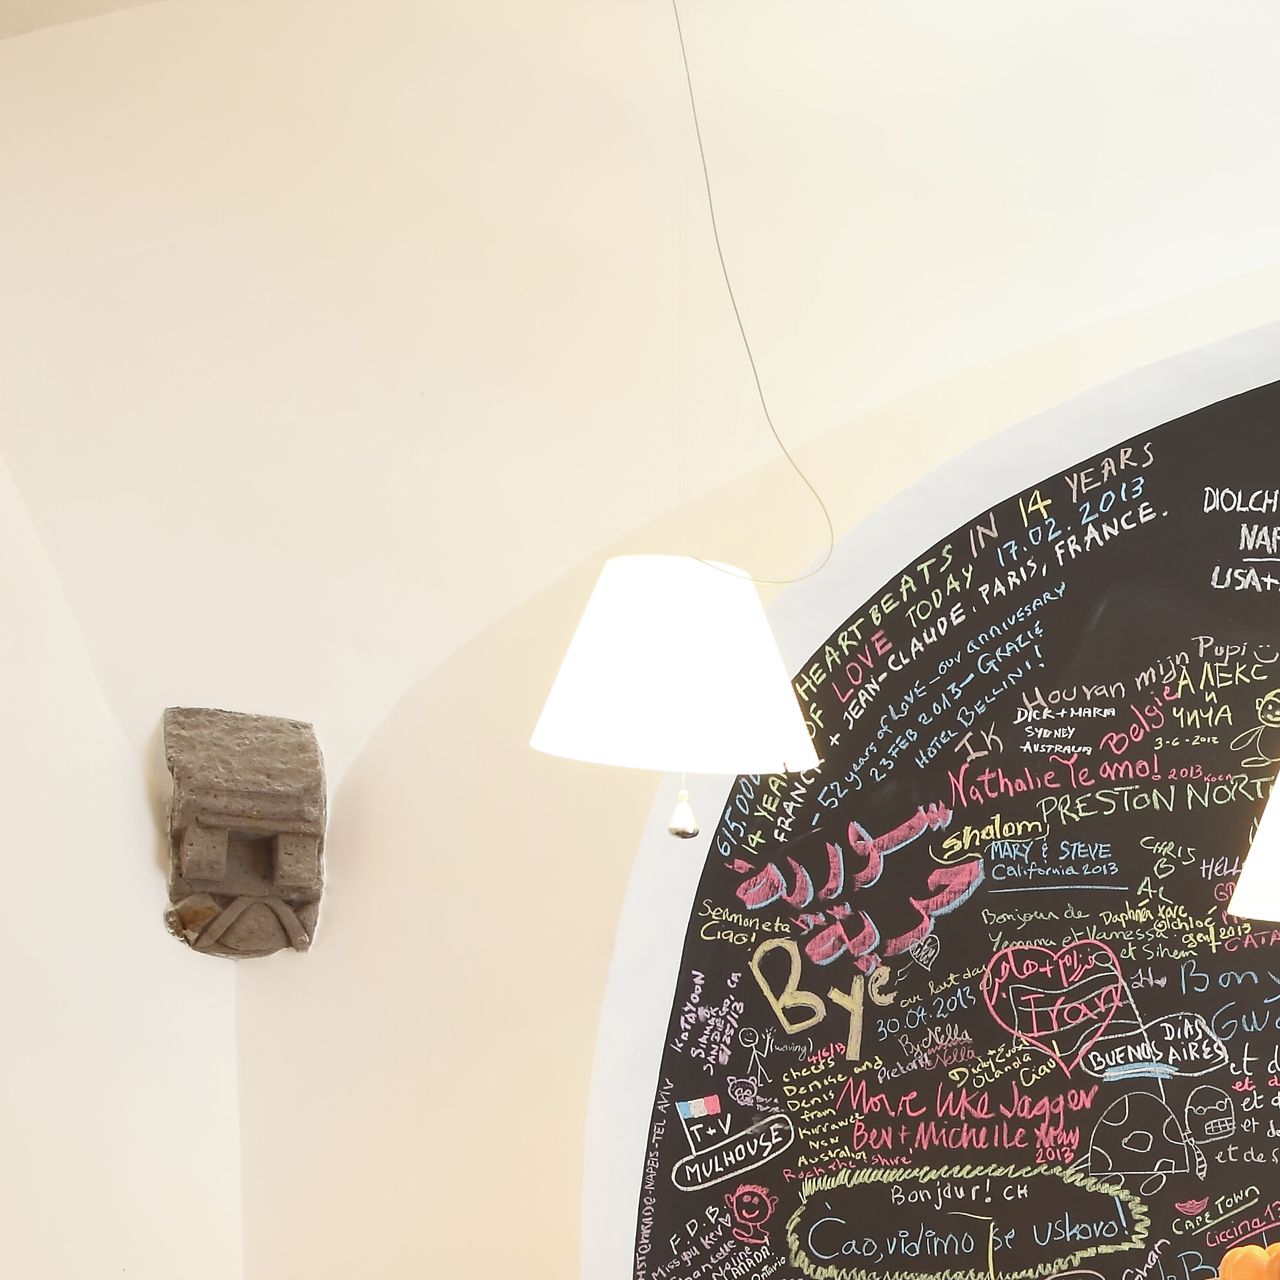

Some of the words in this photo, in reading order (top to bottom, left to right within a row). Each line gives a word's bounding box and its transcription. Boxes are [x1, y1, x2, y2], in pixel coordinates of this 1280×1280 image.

[968, 512, 999, 558] IN
[1019, 489, 1052, 528] 14
[1066, 442, 1154, 502] YEARS
[1203, 487, 1279, 513] DIOLCH
[977, 622, 1043, 676] GRAZIE
[742, 830, 766, 854] 14
[834, 630, 893, 703] LOVE
[905, 564, 973, 627] TODAY
[1079, 476, 1145, 524] 2013
[1024, 726, 1076, 739] SYDNEY
[1168, 766, 1202, 780] 2013
[818, 782, 848, 808] 52
[1037, 785, 1174, 824] PRESTON
[985, 840, 1035, 863] MARY
[1060, 843, 1111, 860] STEVE
[992, 862, 1079, 880] California
[1082, 864, 1119, 876] 2013
[1064, 904, 1090, 918] de
[1089, 1041, 1163, 1070] BUENOS
[1230, 1042, 1258, 1075] et
[1241, 1092, 1265, 1110] et
[1242, 1119, 1259, 1132] et
[685, 1123, 783, 1182] MULHOUSE
[1036, 1148, 1074, 1164] 2013
[1216, 1150, 1239, 1163] et
[1244, 1148, 1266, 1162] de
[1004, 1185, 1028, 1200] CH
